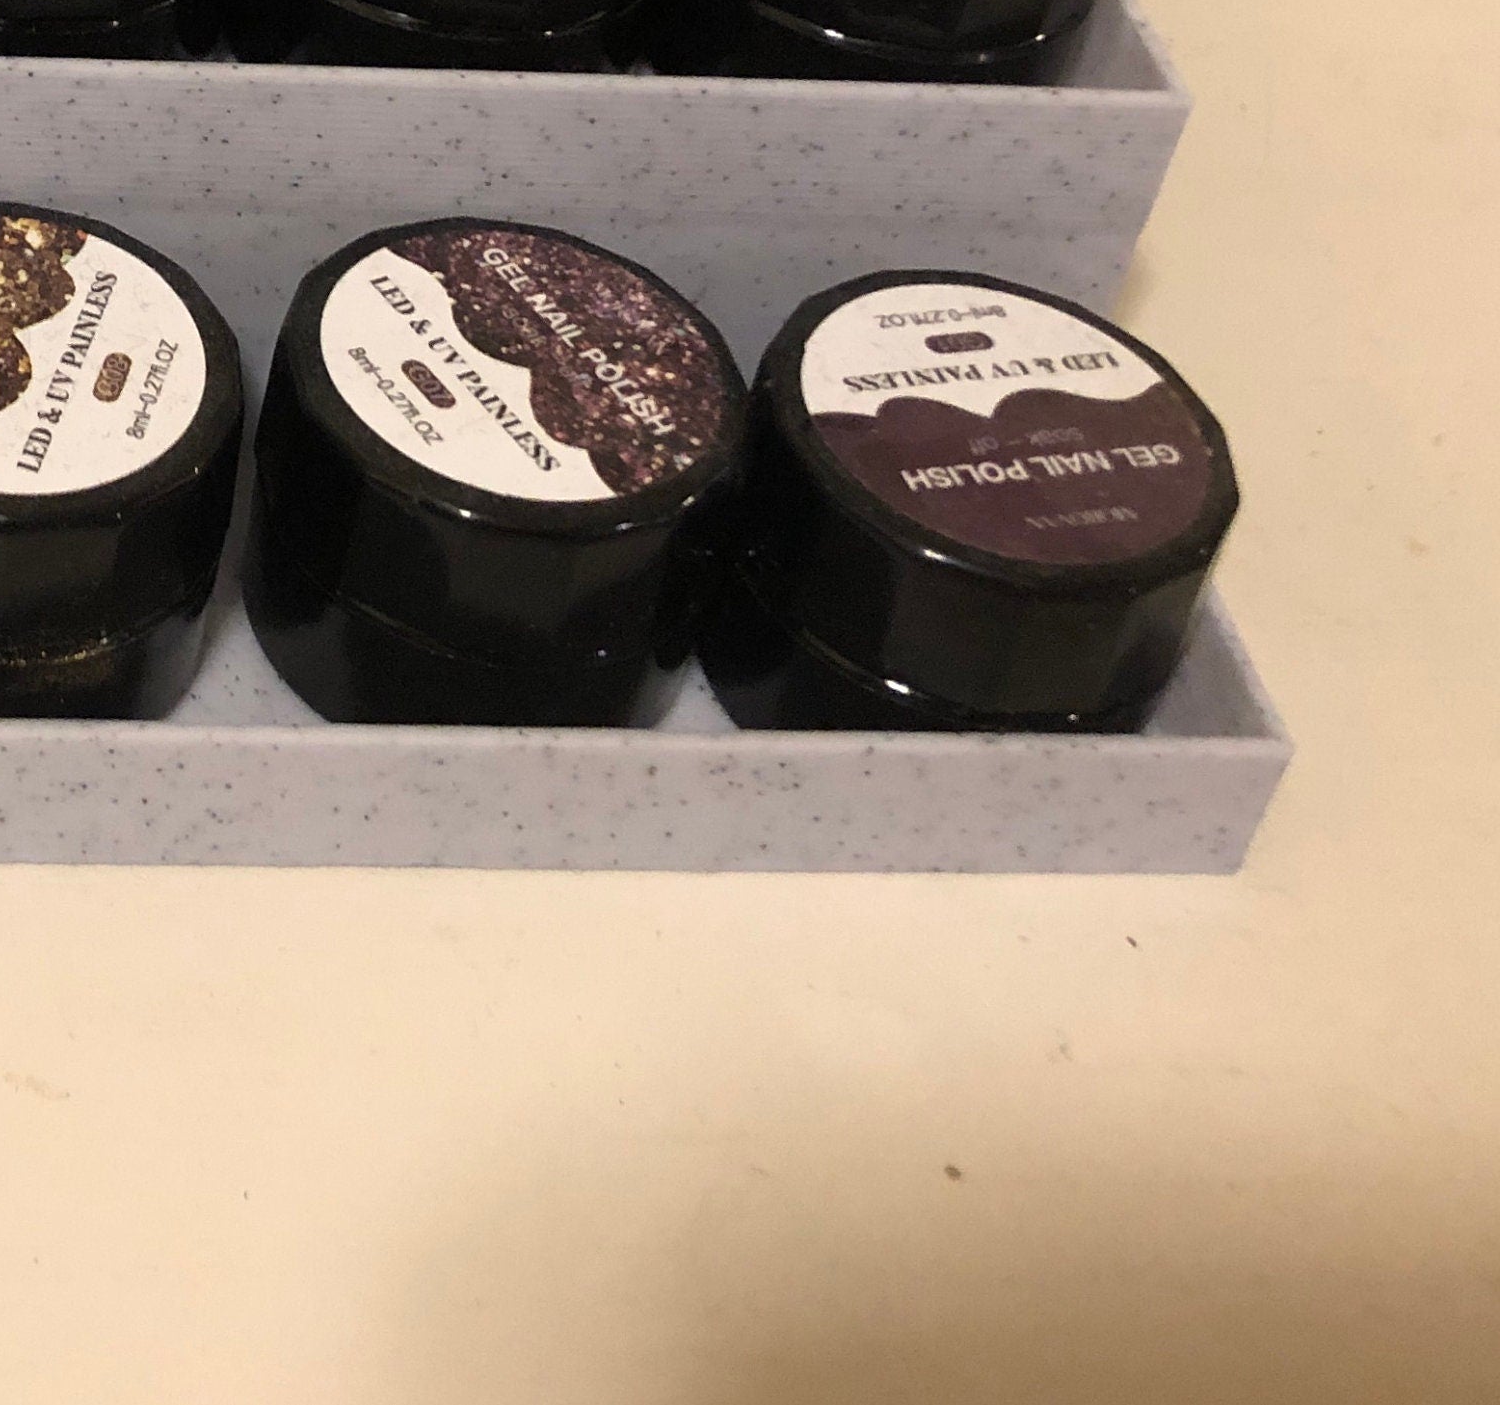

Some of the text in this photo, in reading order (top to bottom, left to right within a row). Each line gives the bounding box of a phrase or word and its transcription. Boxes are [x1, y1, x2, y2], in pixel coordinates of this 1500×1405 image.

[476, 246, 539, 293] GEL
[521, 291, 592, 348] NAIL
[574, 346, 679, 436] POLISH
[1056, 351, 1121, 371] LED
[15, 268, 119, 474] LED & UV PAINLESS
[367, 274, 564, 473] LED & UV PAINLESS
[838, 363, 985, 392] PAINLESS
[979, 359, 1031, 379] UV
[897, 441, 1184, 492] GEL NAIL POLISH
